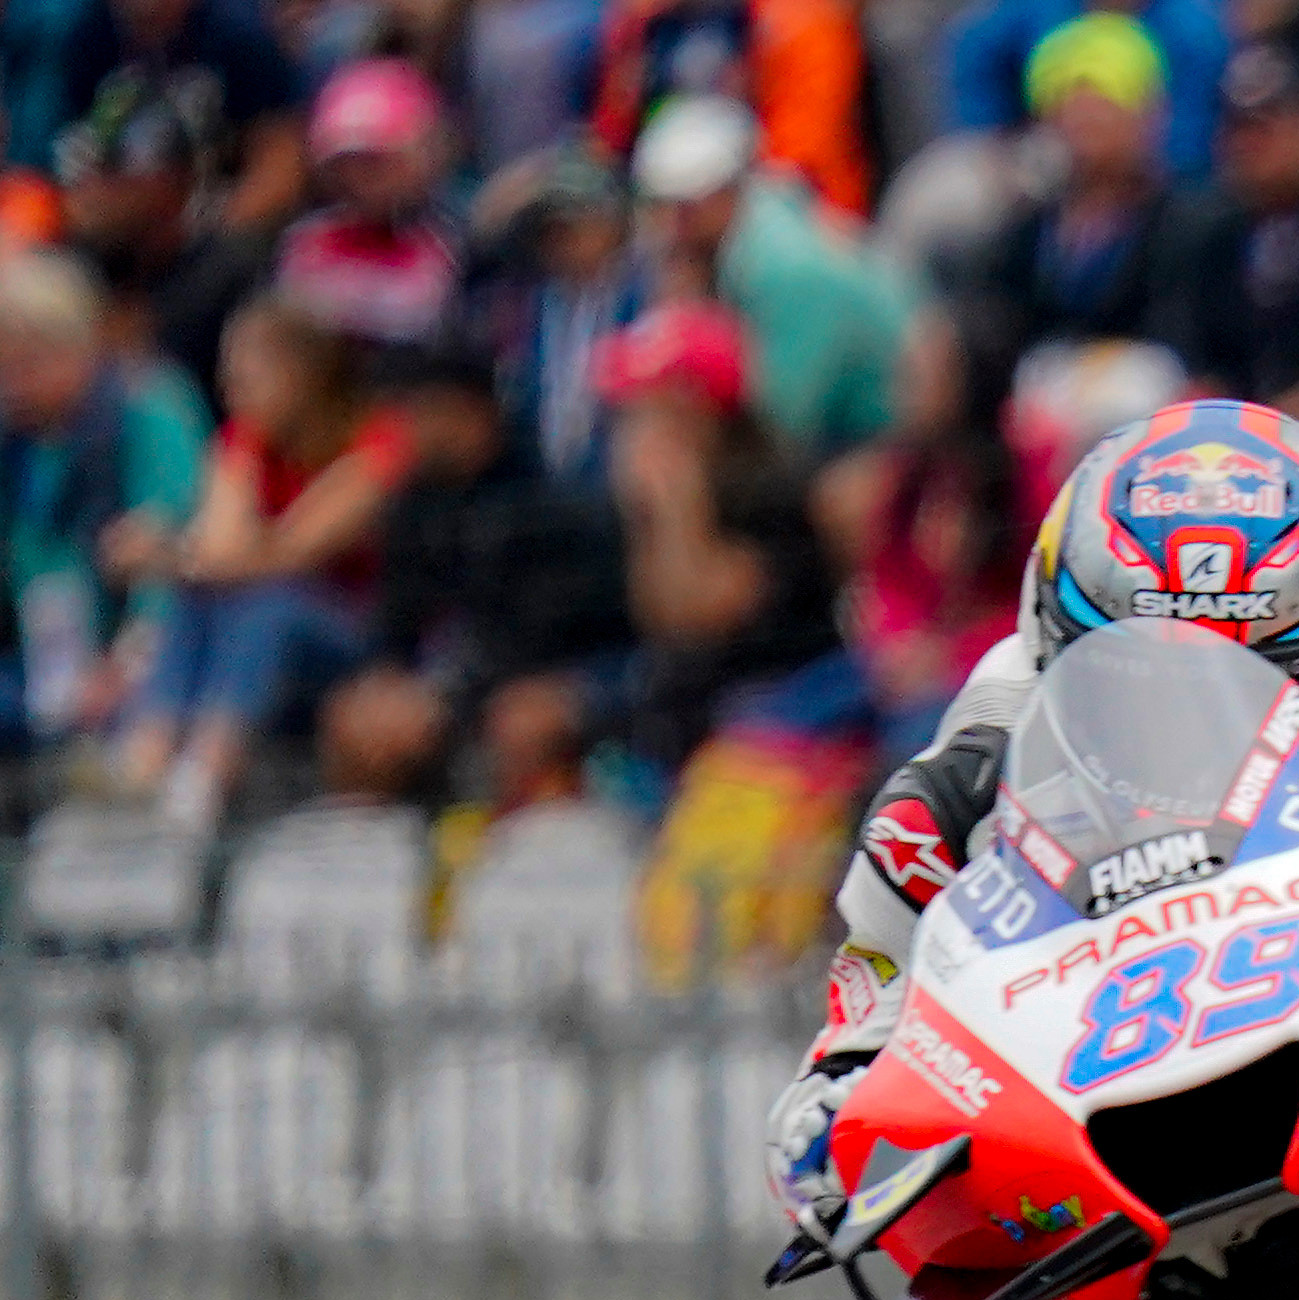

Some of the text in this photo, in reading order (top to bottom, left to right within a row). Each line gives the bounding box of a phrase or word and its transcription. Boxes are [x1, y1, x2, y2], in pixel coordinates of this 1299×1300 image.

[1132, 485, 1283, 517] Red Bull
[1132, 590, 1276, 620] SHARK
[1088, 830, 1211, 897] FIAMM
